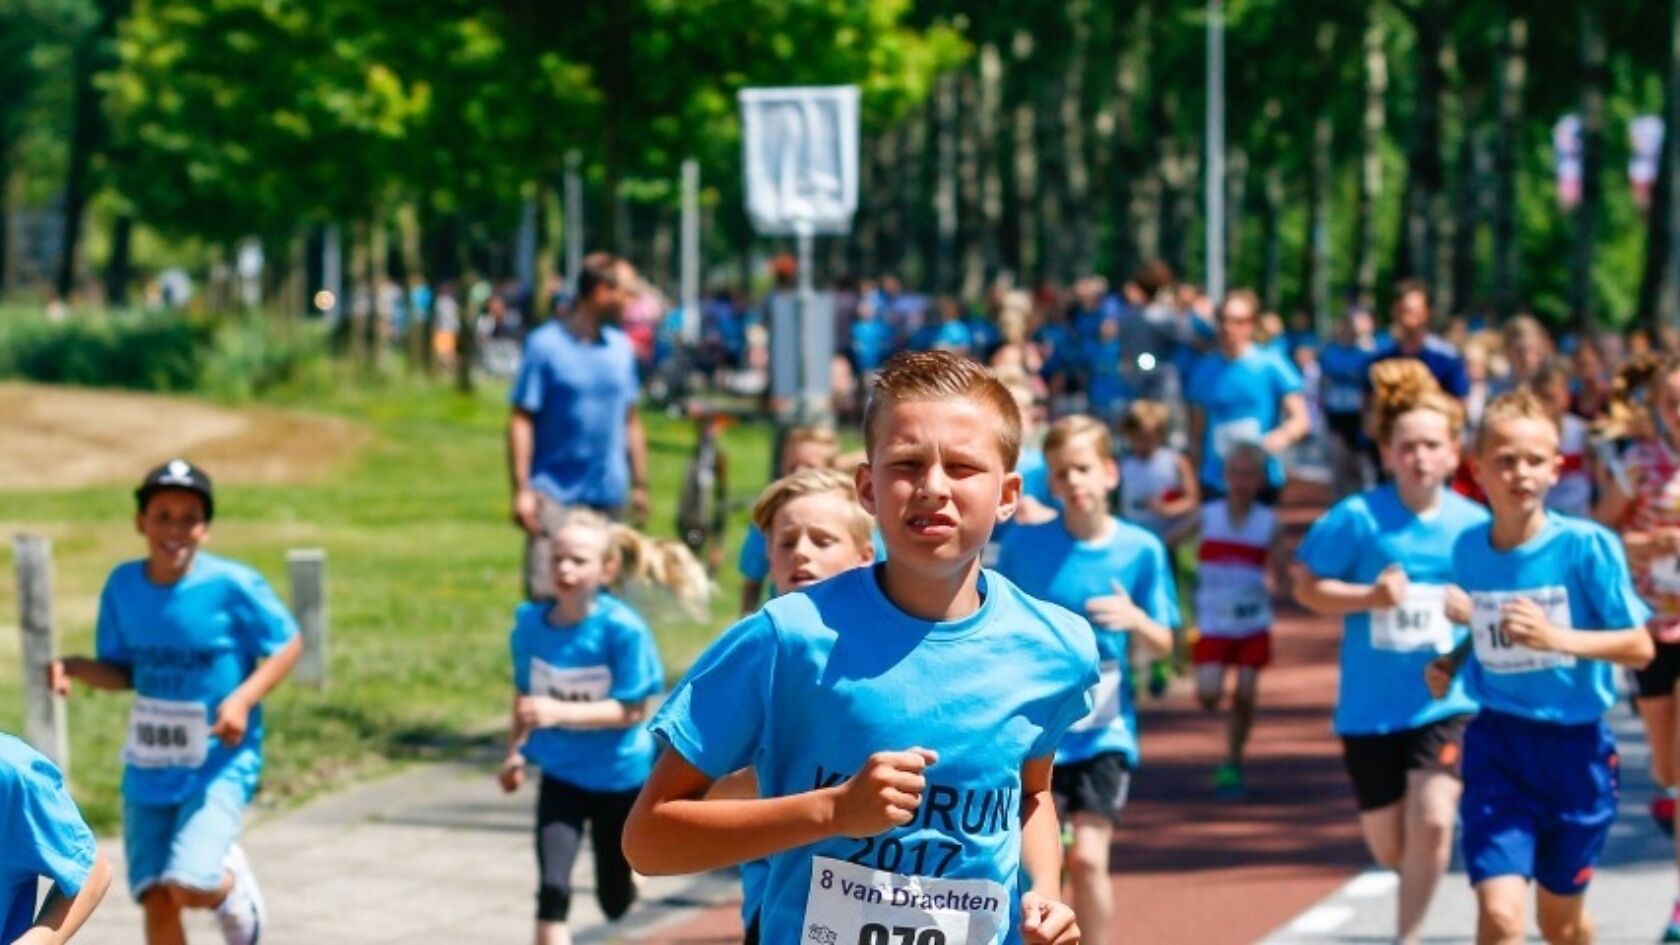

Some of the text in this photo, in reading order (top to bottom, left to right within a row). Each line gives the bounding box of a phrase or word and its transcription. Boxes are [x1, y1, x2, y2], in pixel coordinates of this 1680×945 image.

[135, 721, 188, 749] 1086
[847, 835, 964, 877] 2017
[820, 869, 999, 912] 8 van Drachten
